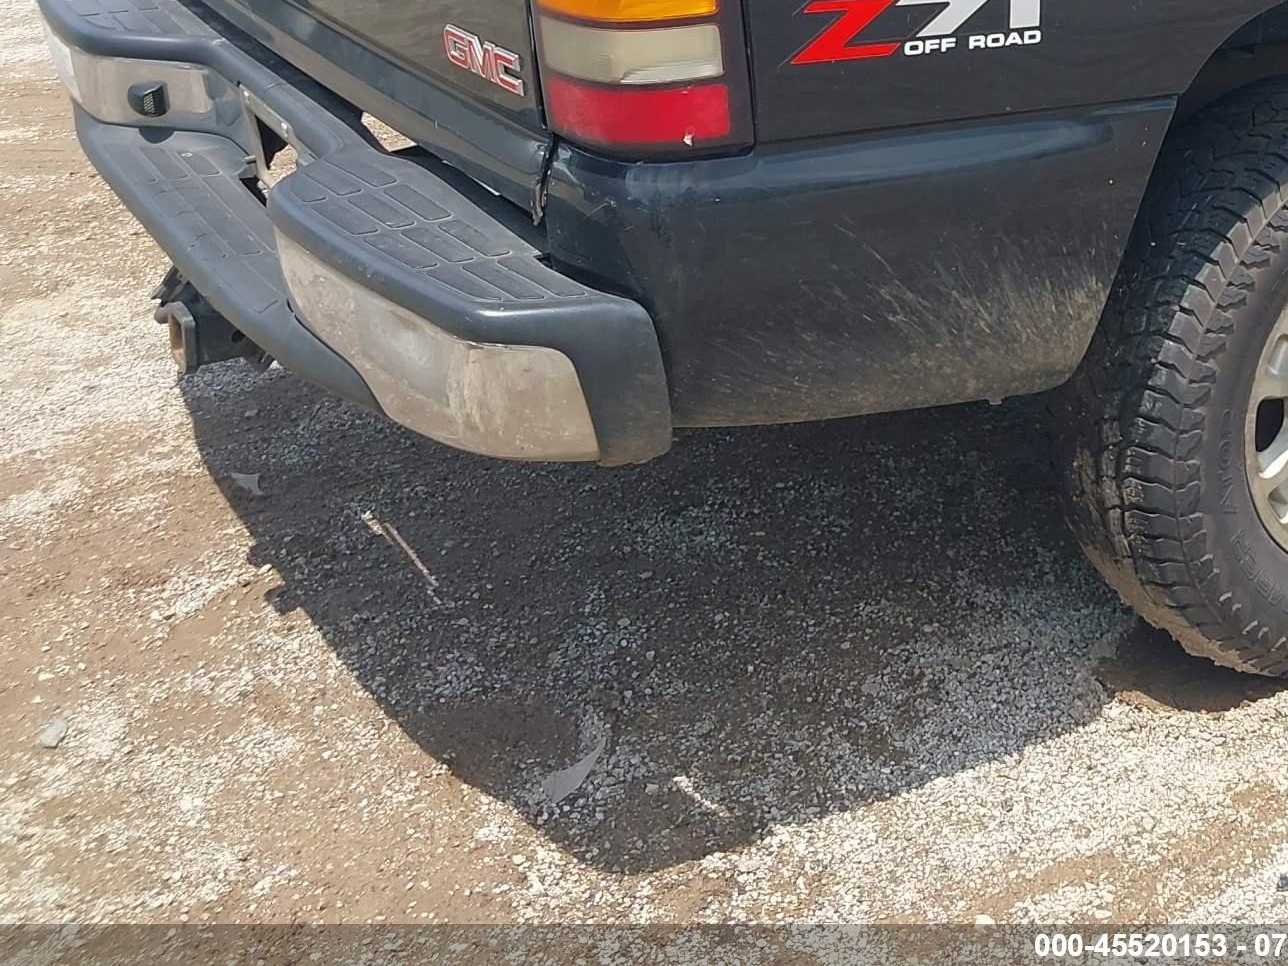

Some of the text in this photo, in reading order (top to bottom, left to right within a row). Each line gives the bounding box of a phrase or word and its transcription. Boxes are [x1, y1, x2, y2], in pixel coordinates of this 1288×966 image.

[443, 23, 525, 98] GMC
[904, 30, 1042, 56] OFF ROAD
